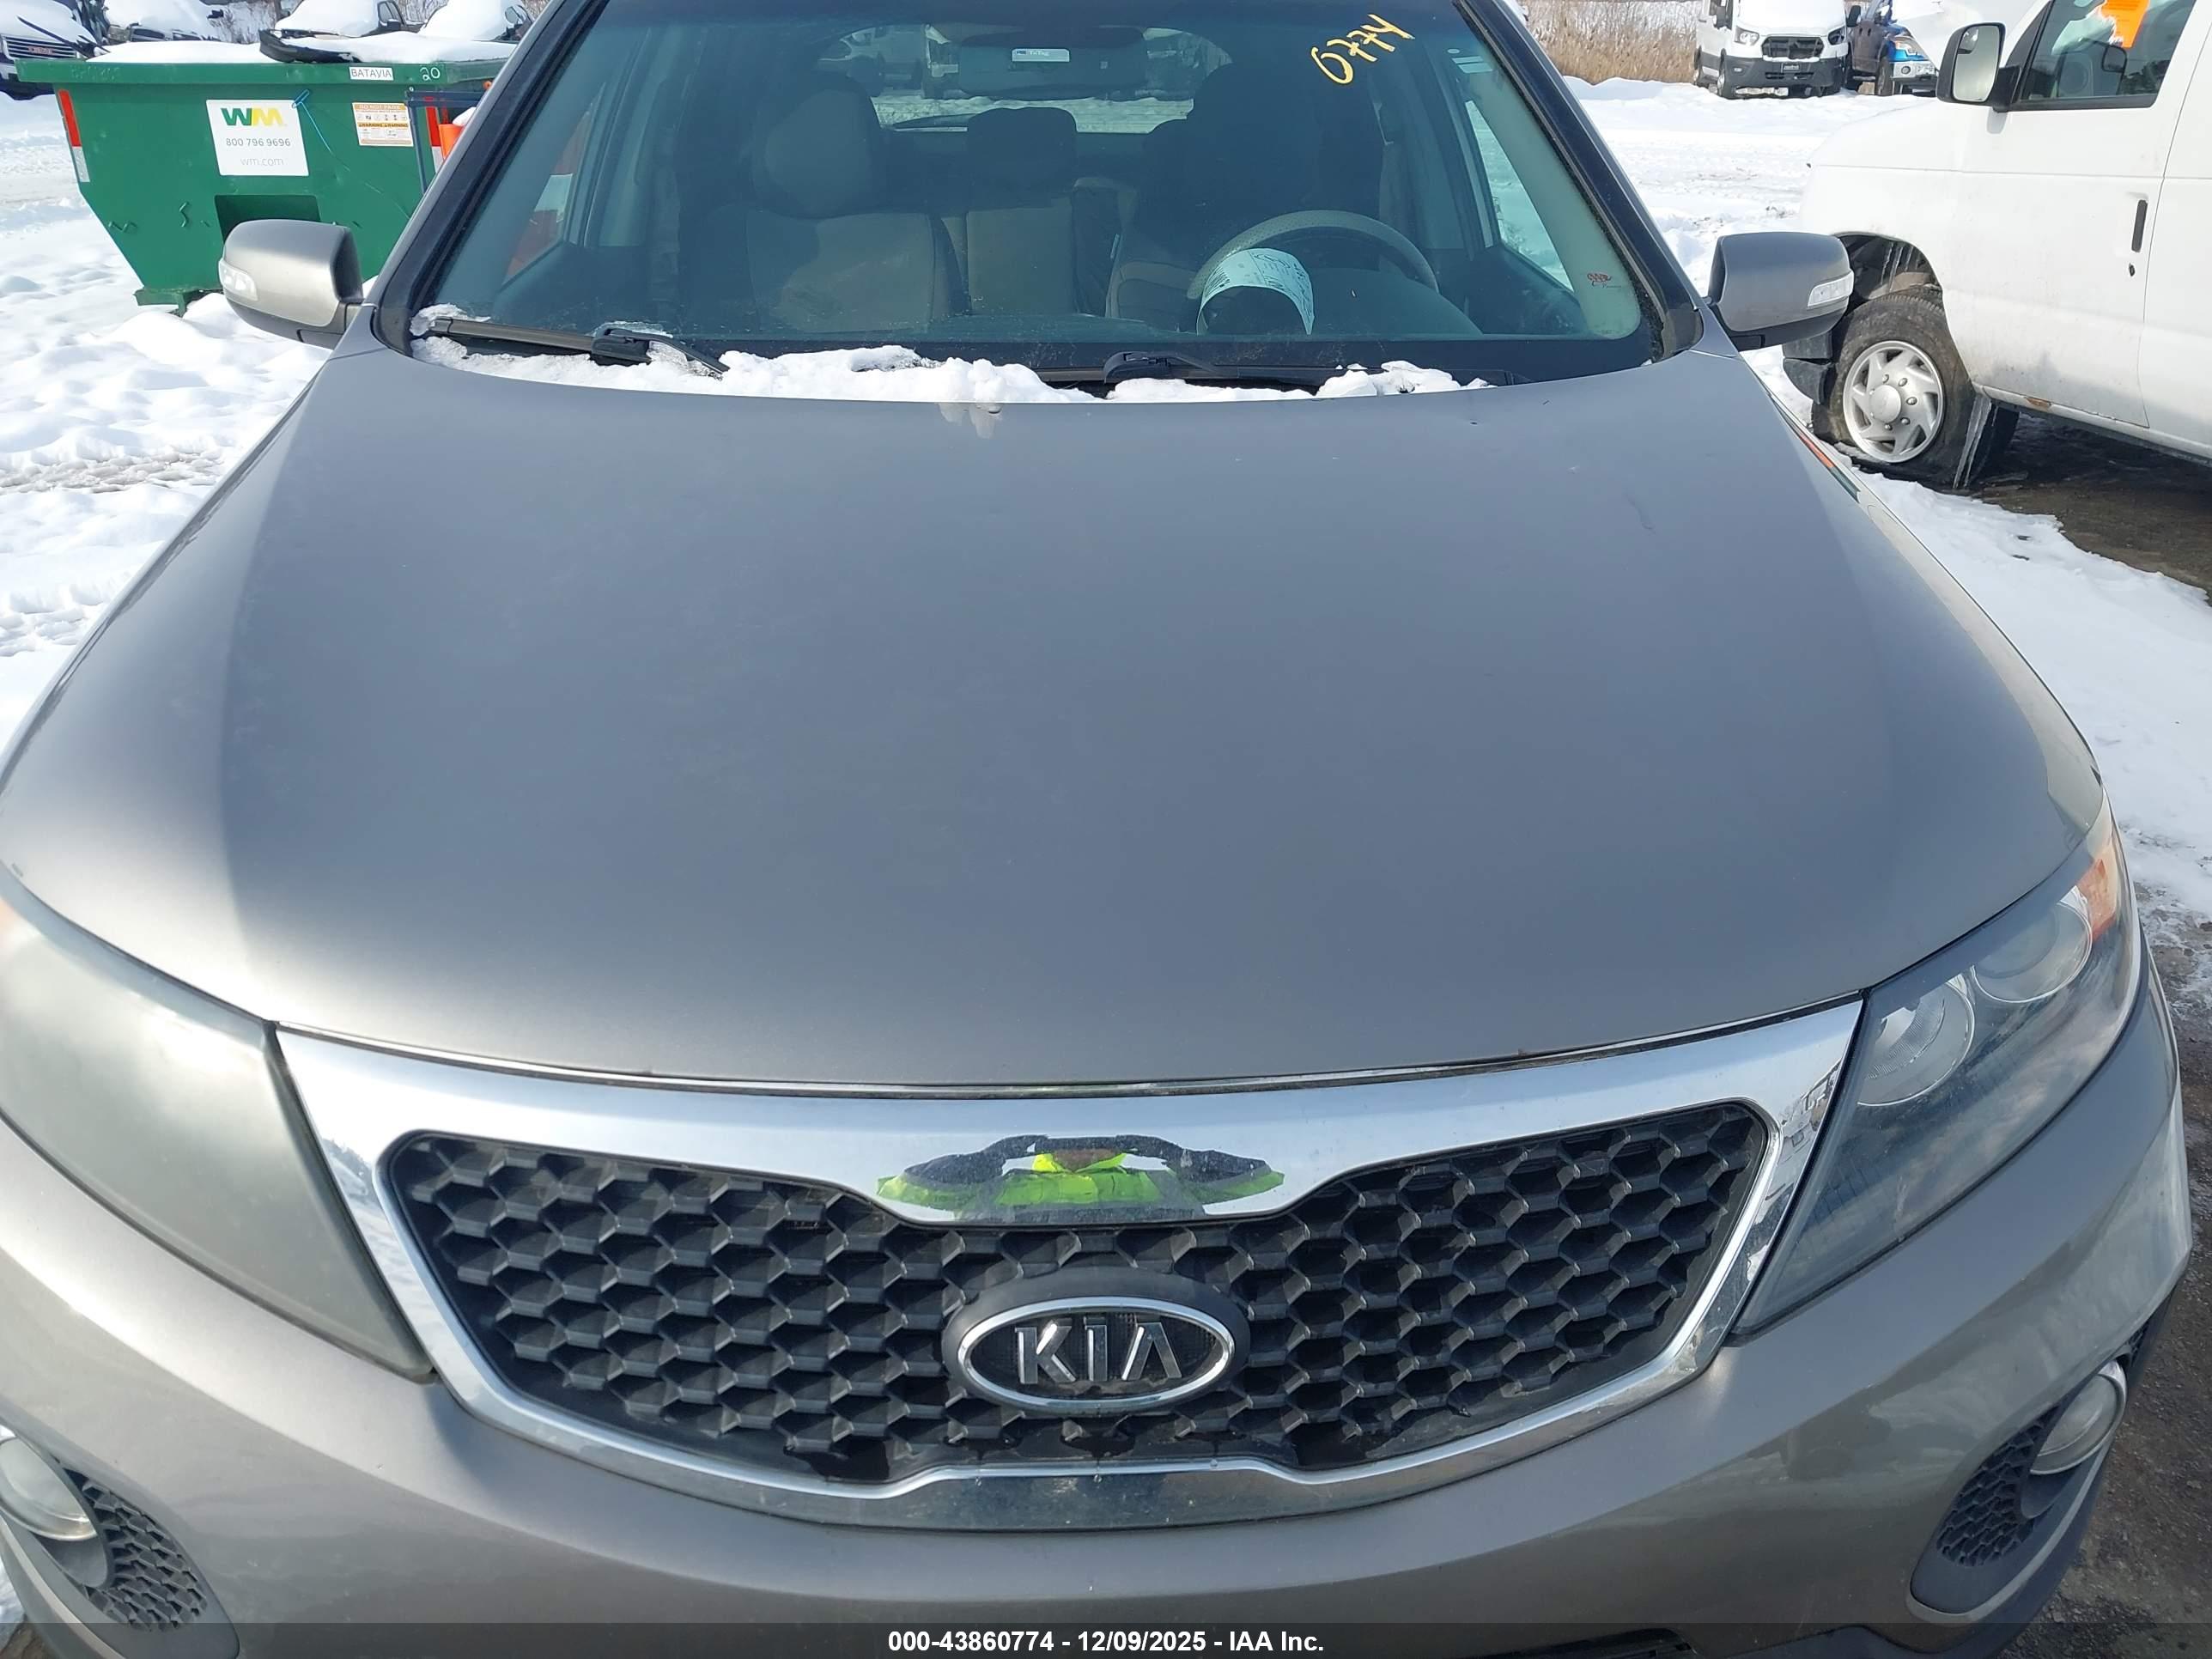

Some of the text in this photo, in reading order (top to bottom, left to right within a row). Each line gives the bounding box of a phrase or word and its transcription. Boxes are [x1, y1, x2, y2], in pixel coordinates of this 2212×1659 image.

[351, 69, 392, 78] BATAVIA
[420, 67, 441, 82] 20
[221, 107, 284, 126] WM
[226, 138, 291, 147] 800 796 9696
[240, 158, 284, 167] wm.com
[1015, 1322, 1182, 1384] KIA
